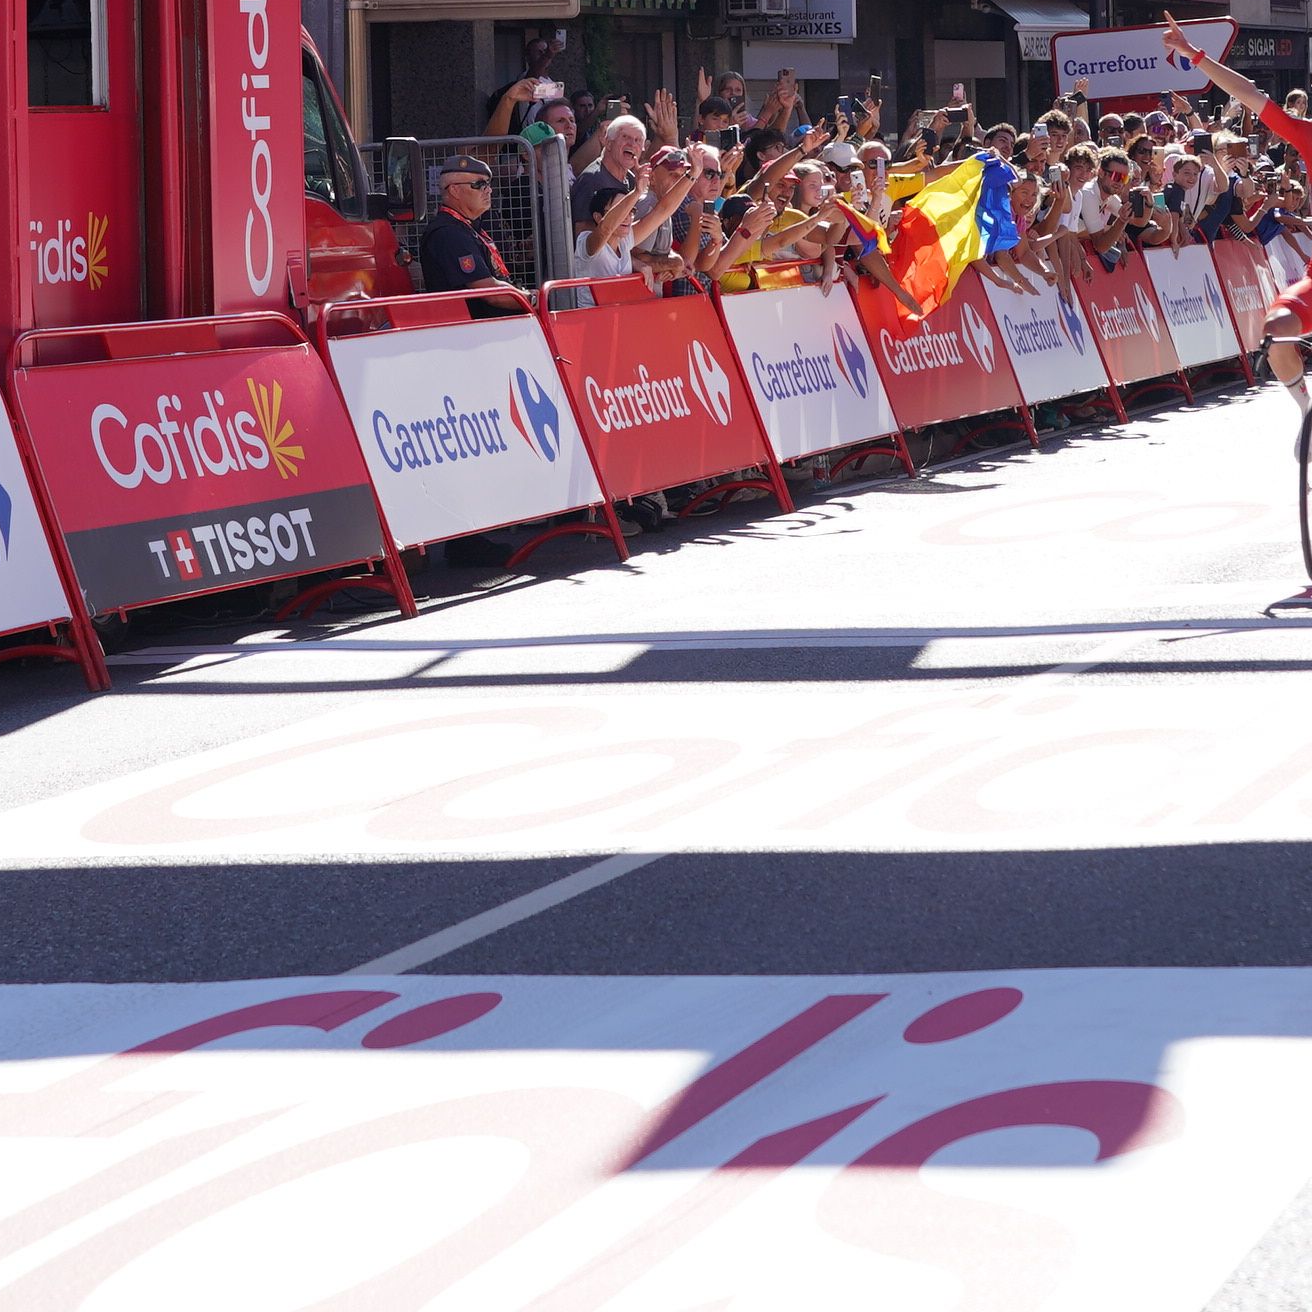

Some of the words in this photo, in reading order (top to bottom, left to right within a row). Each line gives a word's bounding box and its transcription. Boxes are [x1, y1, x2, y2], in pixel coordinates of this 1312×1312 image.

[785, 10, 836, 21] estaurant
[788, 21, 842, 36] BAIXES
[1064, 54, 1157, 76] Carrefour
[1004, 312, 1062, 356] Carrefour
[1093, 305, 1140, 343] Carrefour
[1162, 296, 1206, 328] Carrefour
[751, 343, 837, 402] Carrefour
[880, 324, 963, 375] Carrefour
[585, 364, 691, 433] Carrefour
[91, 389, 270, 489] Cofidis
[372, 396, 508, 472] Carrefour
[196, 507, 318, 577] TISSOT
